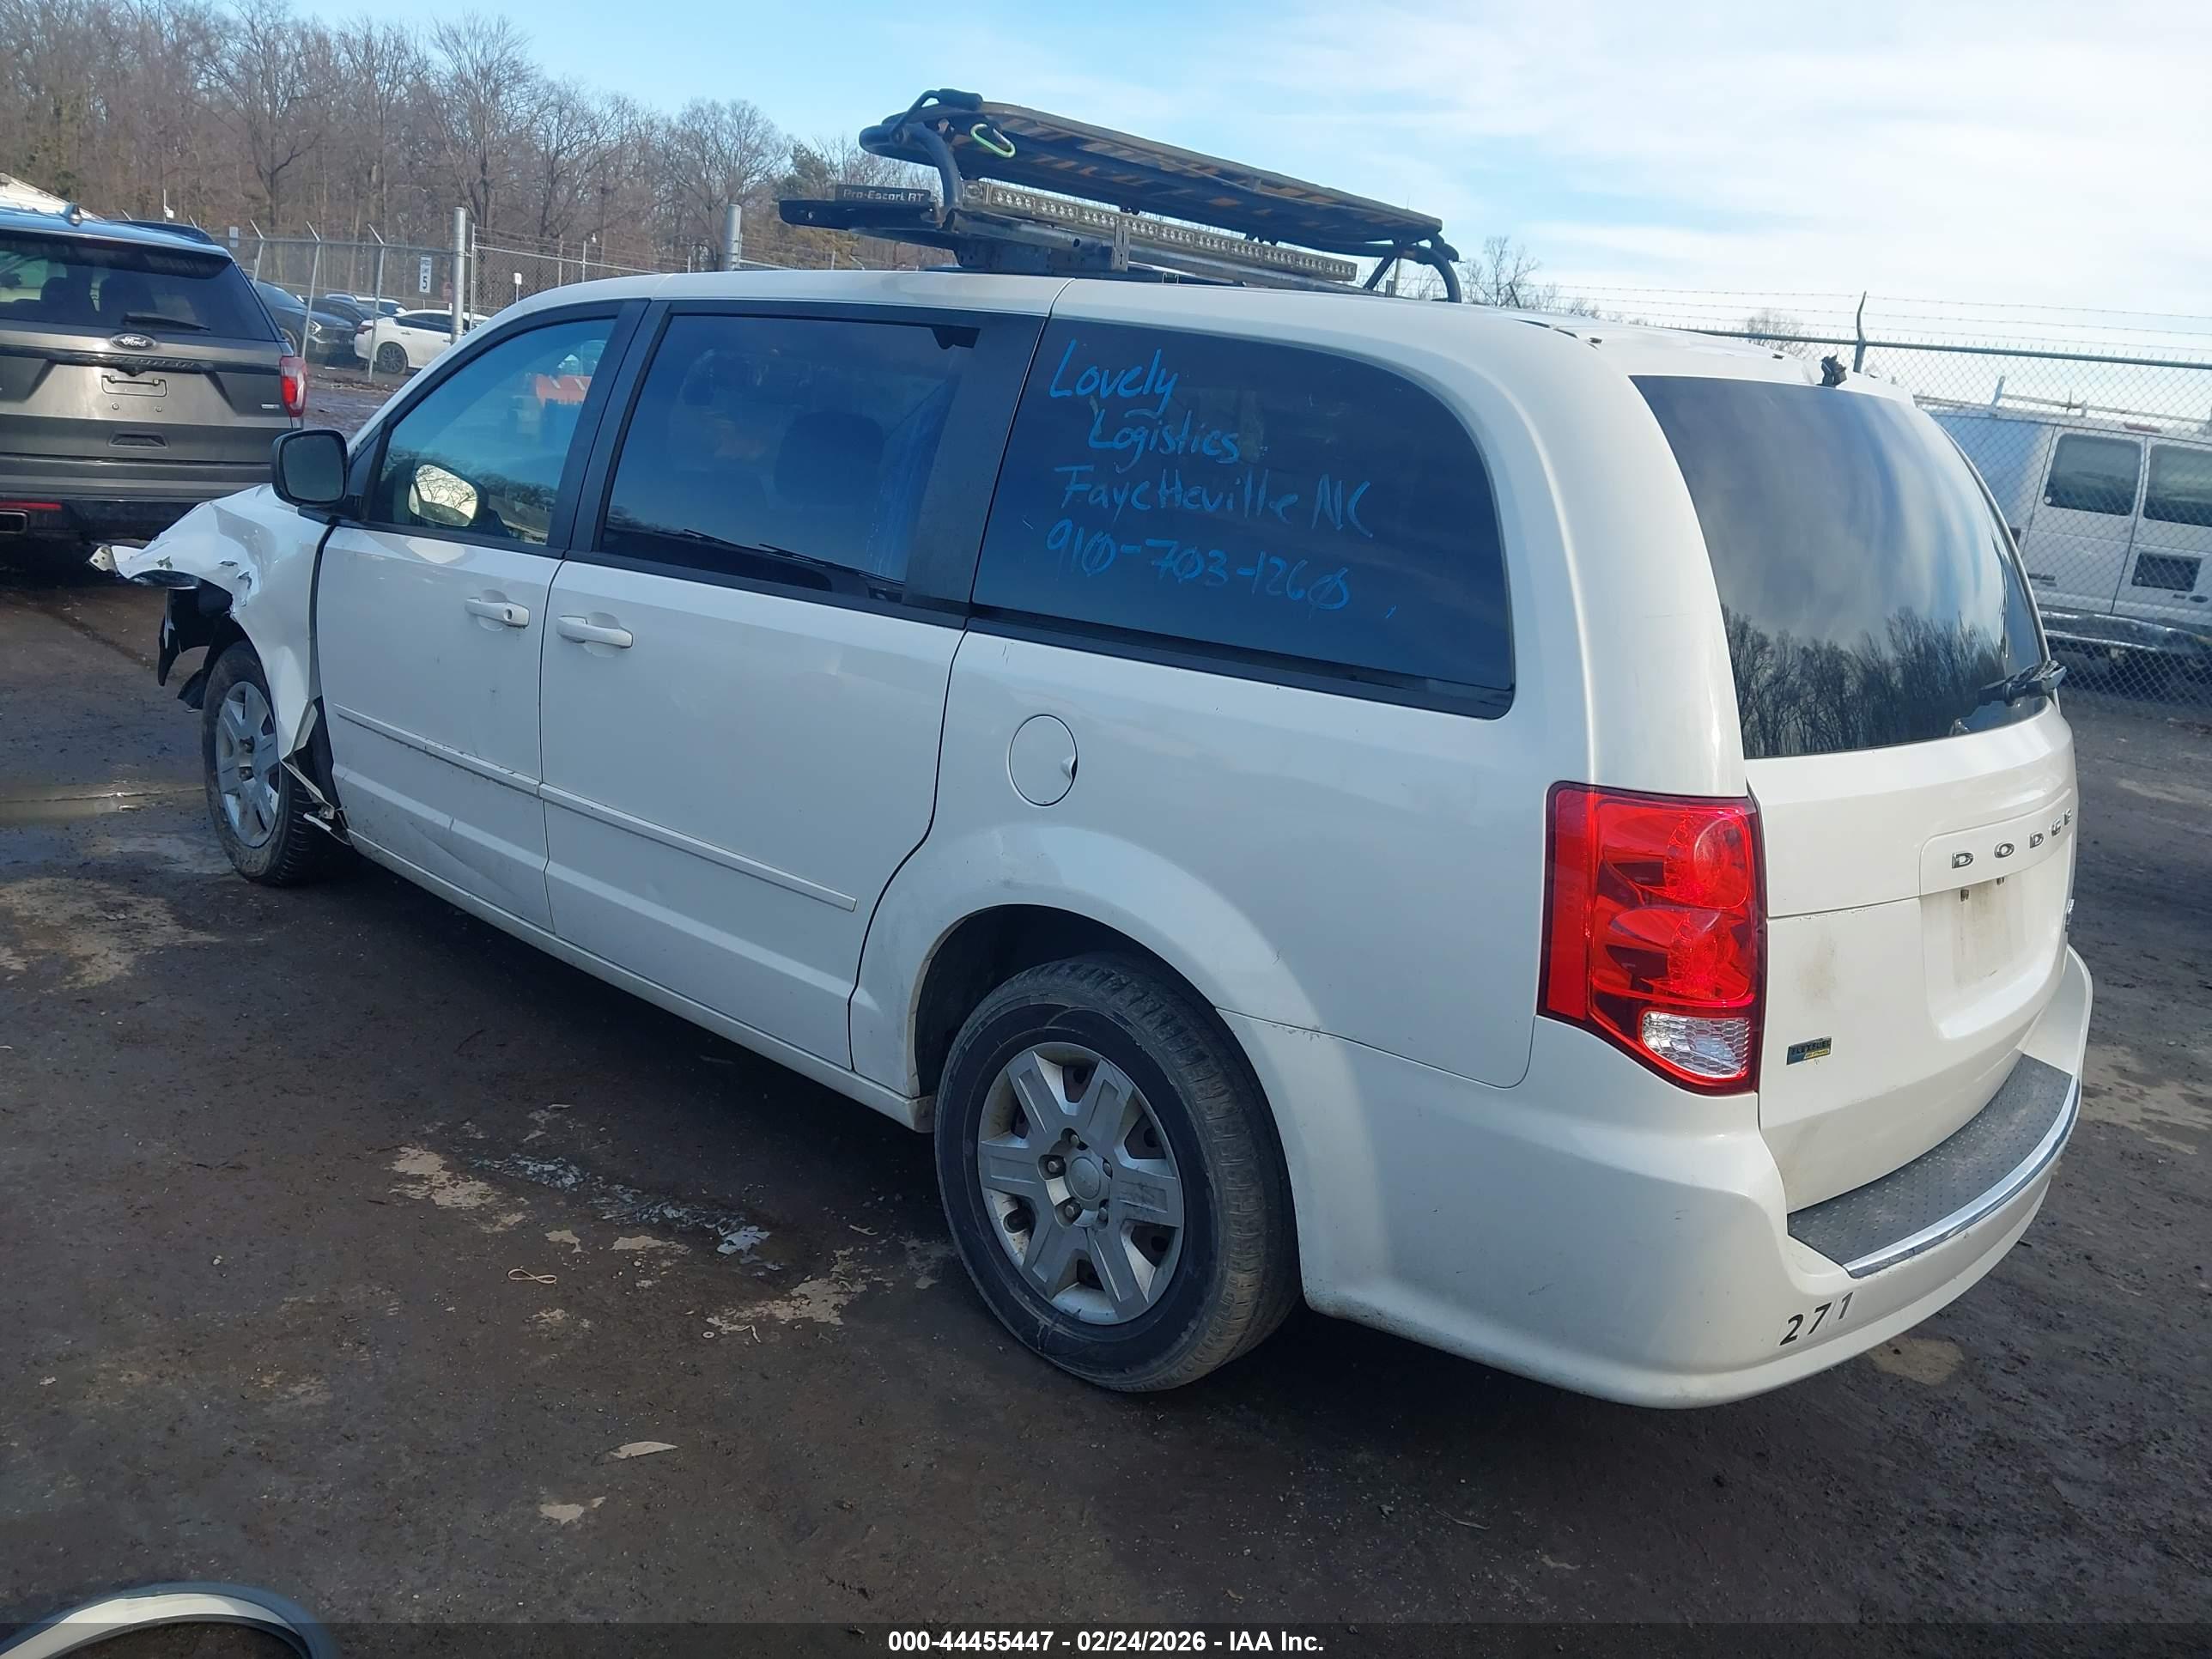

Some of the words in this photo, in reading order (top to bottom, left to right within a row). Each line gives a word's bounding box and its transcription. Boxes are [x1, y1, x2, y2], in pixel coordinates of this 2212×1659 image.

[908, 191, 926, 203] RT
[422, 275, 428, 289] 5
[121, 335, 147, 348] Ford
[1049, 338, 1179, 417] Lovely
[1088, 408, 1239, 473] Logistics
[1054, 465, 1299, 525] Fayetteville
[1311, 473, 1374, 538] NC
[1046, 519, 1350, 618] 910-703-1260
[1951, 807, 2073, 869] DODGE
[1778, 1291, 1854, 1346] 271
